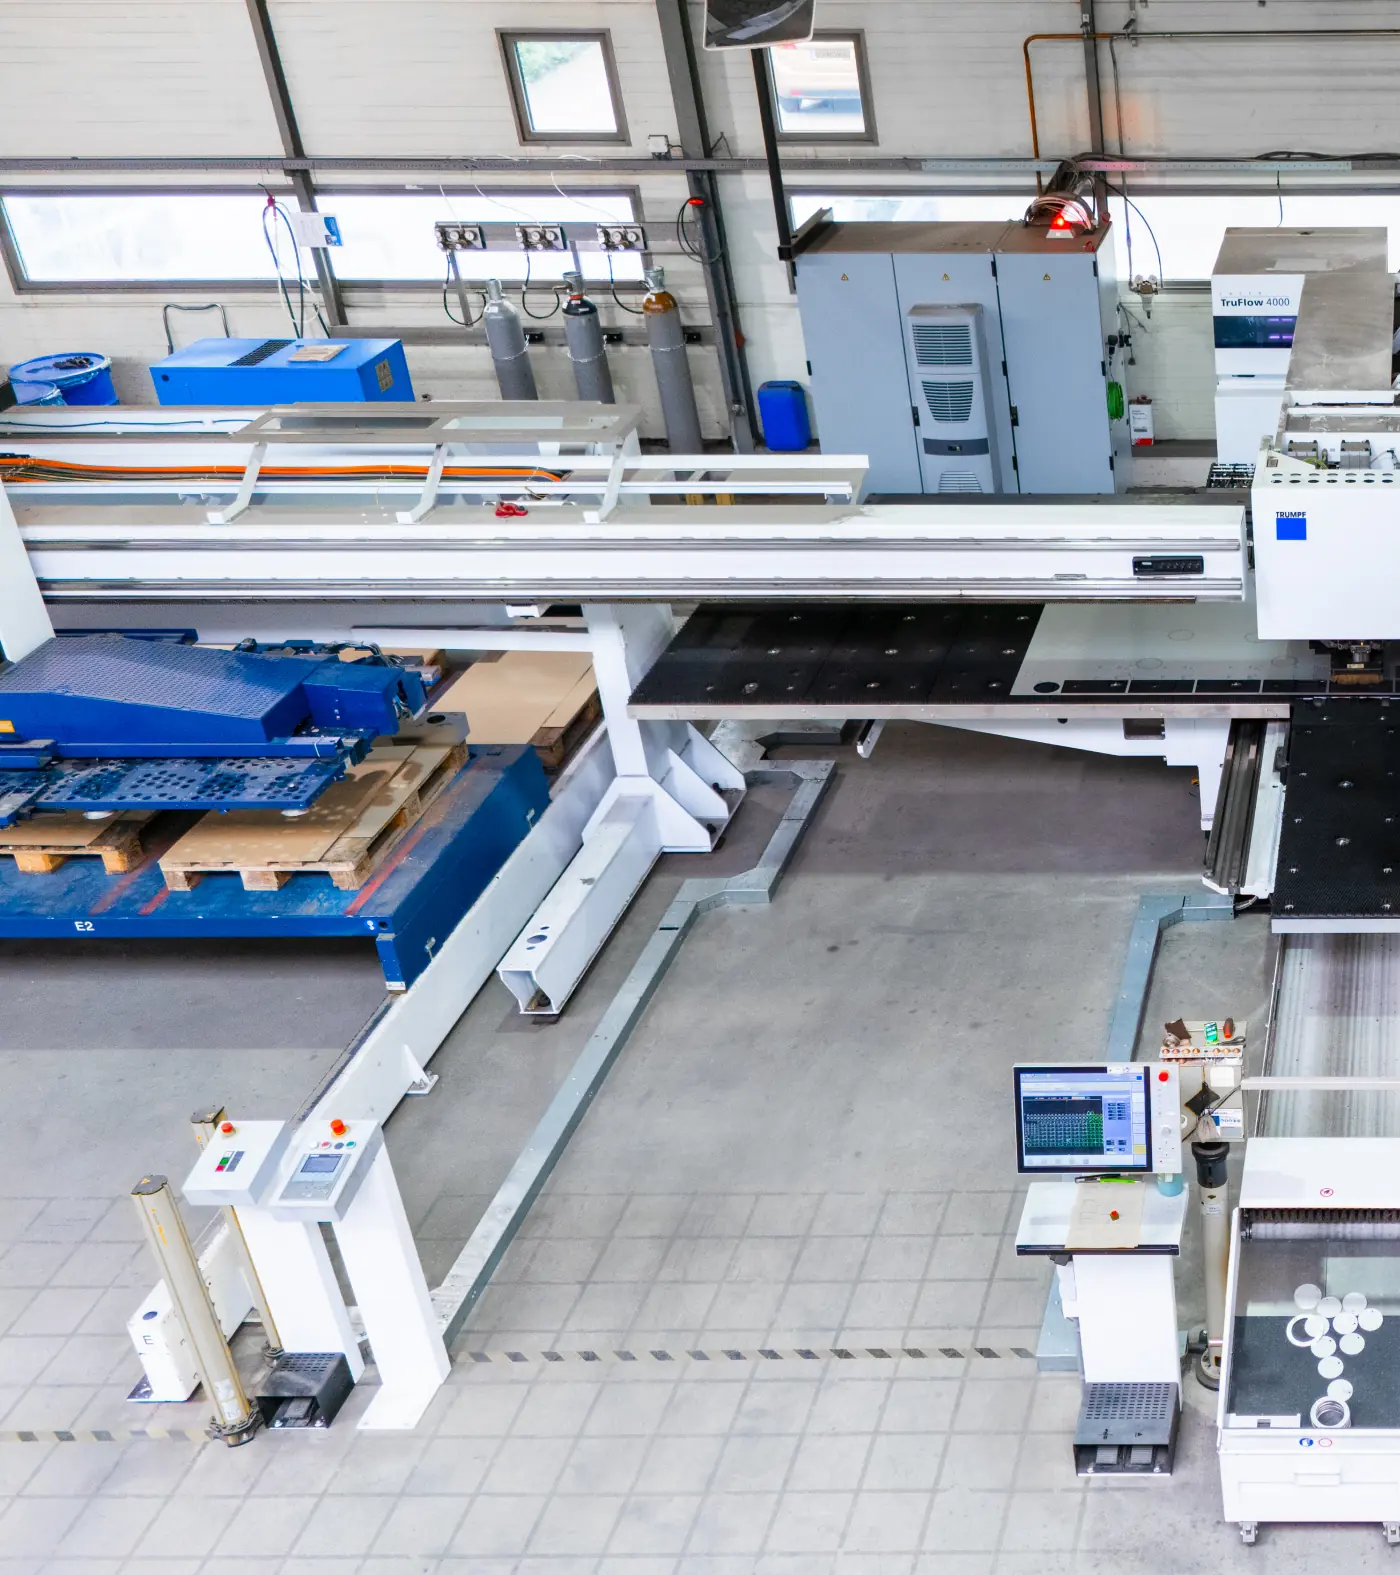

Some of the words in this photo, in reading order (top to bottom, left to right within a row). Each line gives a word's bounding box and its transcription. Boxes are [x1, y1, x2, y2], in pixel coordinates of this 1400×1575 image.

[1220, 298, 1264, 307] TruFlow
[1266, 298, 1290, 307] 4000
[74, 920, 96, 931] E2
